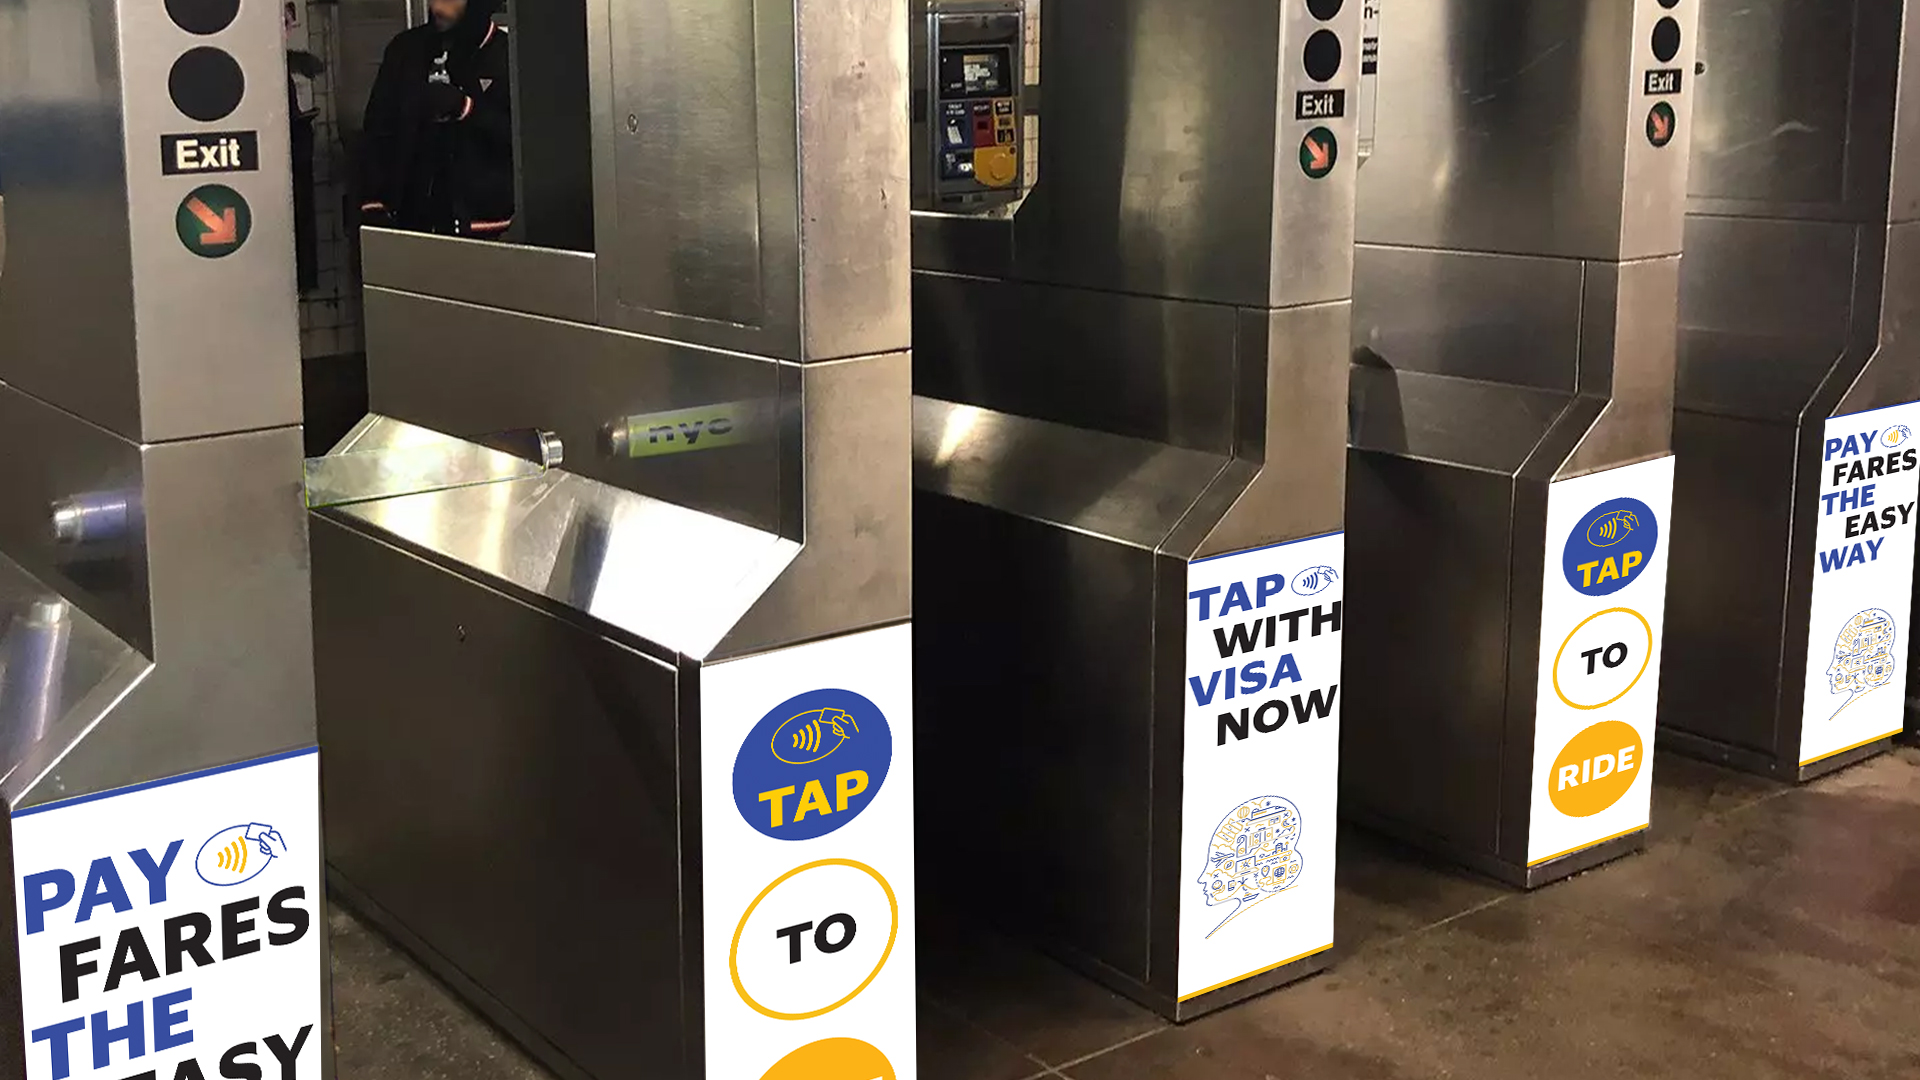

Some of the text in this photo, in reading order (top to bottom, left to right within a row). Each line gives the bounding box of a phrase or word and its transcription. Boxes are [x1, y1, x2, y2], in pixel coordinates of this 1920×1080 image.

[1301, 94, 1334, 116] Exit
[1648, 73, 1674, 92] Exit
[175, 138, 241, 169] Exit
[1824, 429, 1879, 462] PAY
[1832, 448, 1917, 487] FARES
[1821, 483, 1876, 516] THE
[1844, 501, 1915, 539] EASY
[1576, 550, 1643, 588] TAP
[1819, 536, 1885, 574] WAY
[1188, 573, 1286, 622] TAP
[1213, 600, 1342, 659] WITH
[1188, 652, 1303, 707] VISA
[1580, 641, 1628, 675] TO
[1217, 684, 1338, 747] NOW
[1557, 744, 1636, 792] RIDE
[758, 769, 869, 828] TAP
[22, 838, 185, 936] PAY
[59, 885, 310, 1004] FARES
[776, 912, 857, 965] TO
[31, 987, 194, 1080] THE
[118, 1023, 314, 1080] SY
